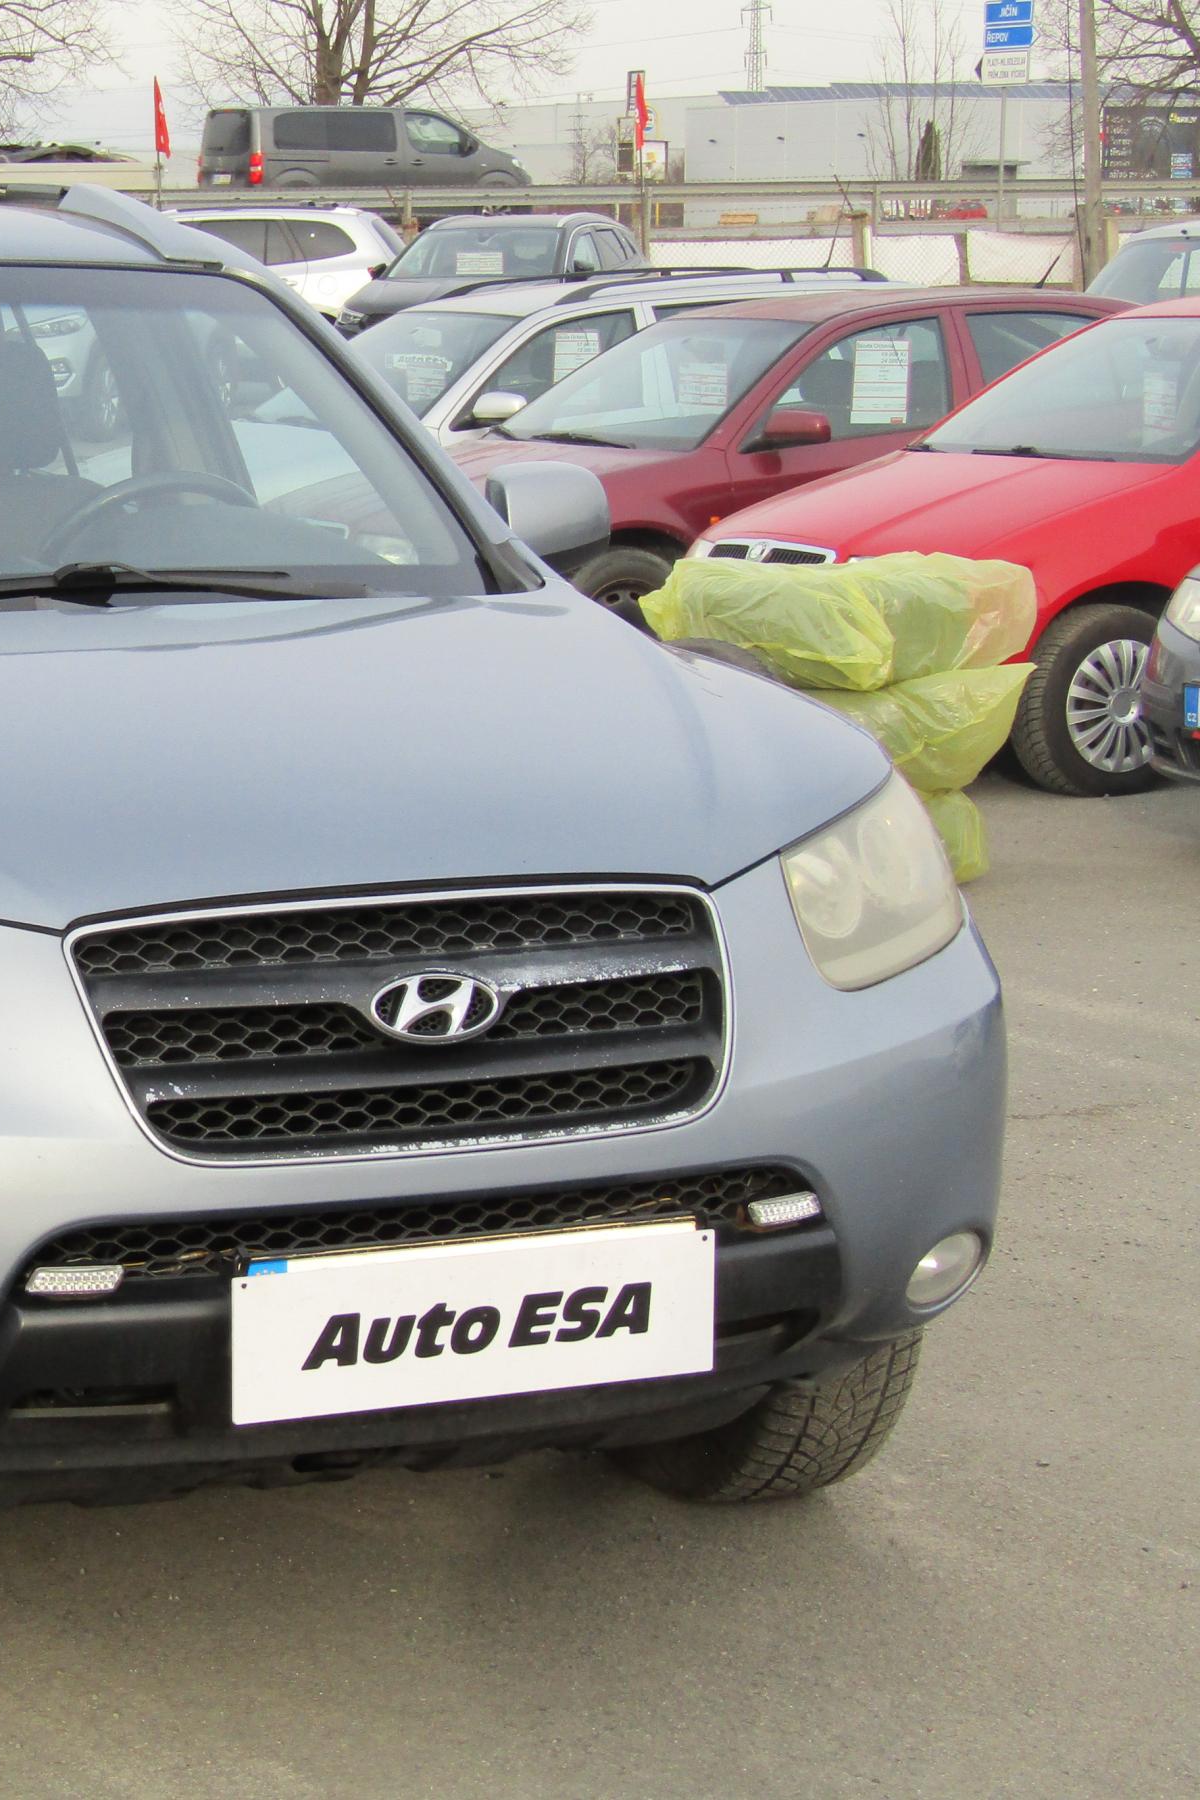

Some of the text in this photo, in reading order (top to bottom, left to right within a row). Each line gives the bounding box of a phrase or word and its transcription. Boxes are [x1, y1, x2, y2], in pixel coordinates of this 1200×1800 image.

[986, 31, 1009, 43] ŘEPOV
[301, 1282, 652, 1370] Auto ESA
